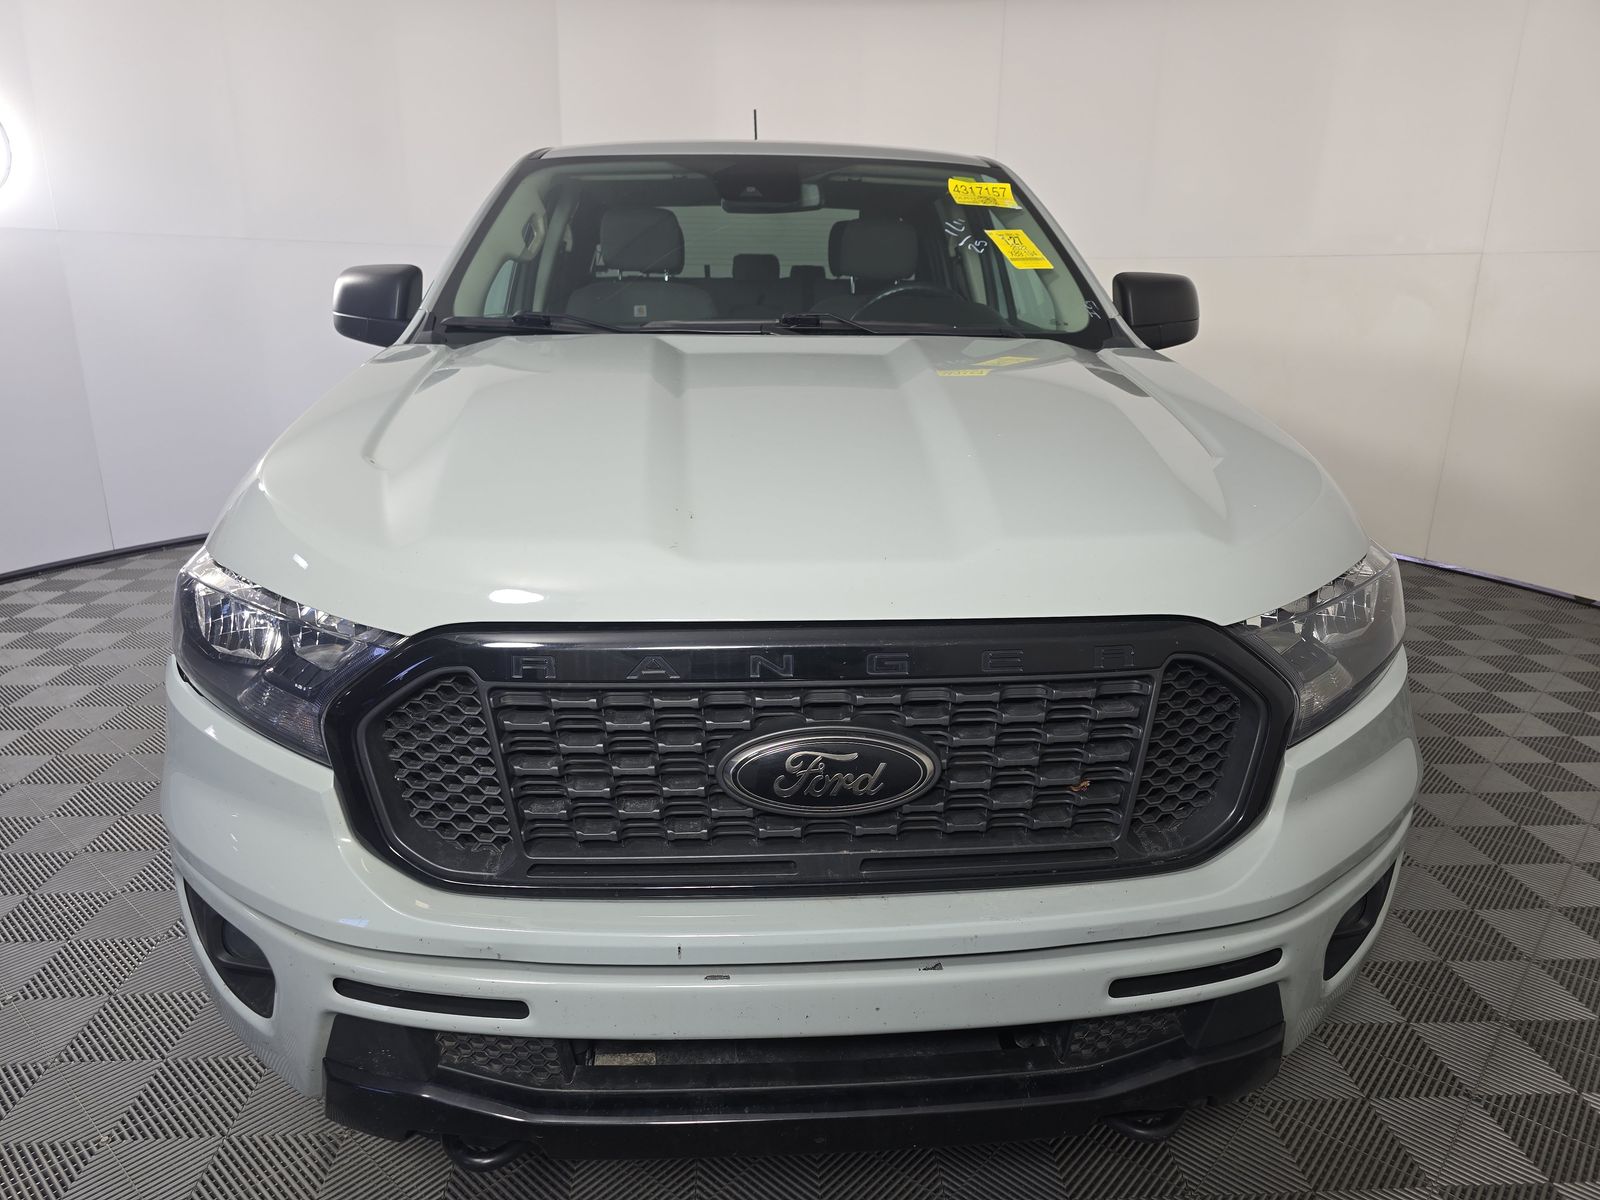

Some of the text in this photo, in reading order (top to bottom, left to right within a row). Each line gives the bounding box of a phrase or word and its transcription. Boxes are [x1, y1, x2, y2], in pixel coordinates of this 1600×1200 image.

[953, 184, 1007, 197] 4317157
[512, 644, 1136, 679] RANGER
[772, 750, 886, 798] Ford
